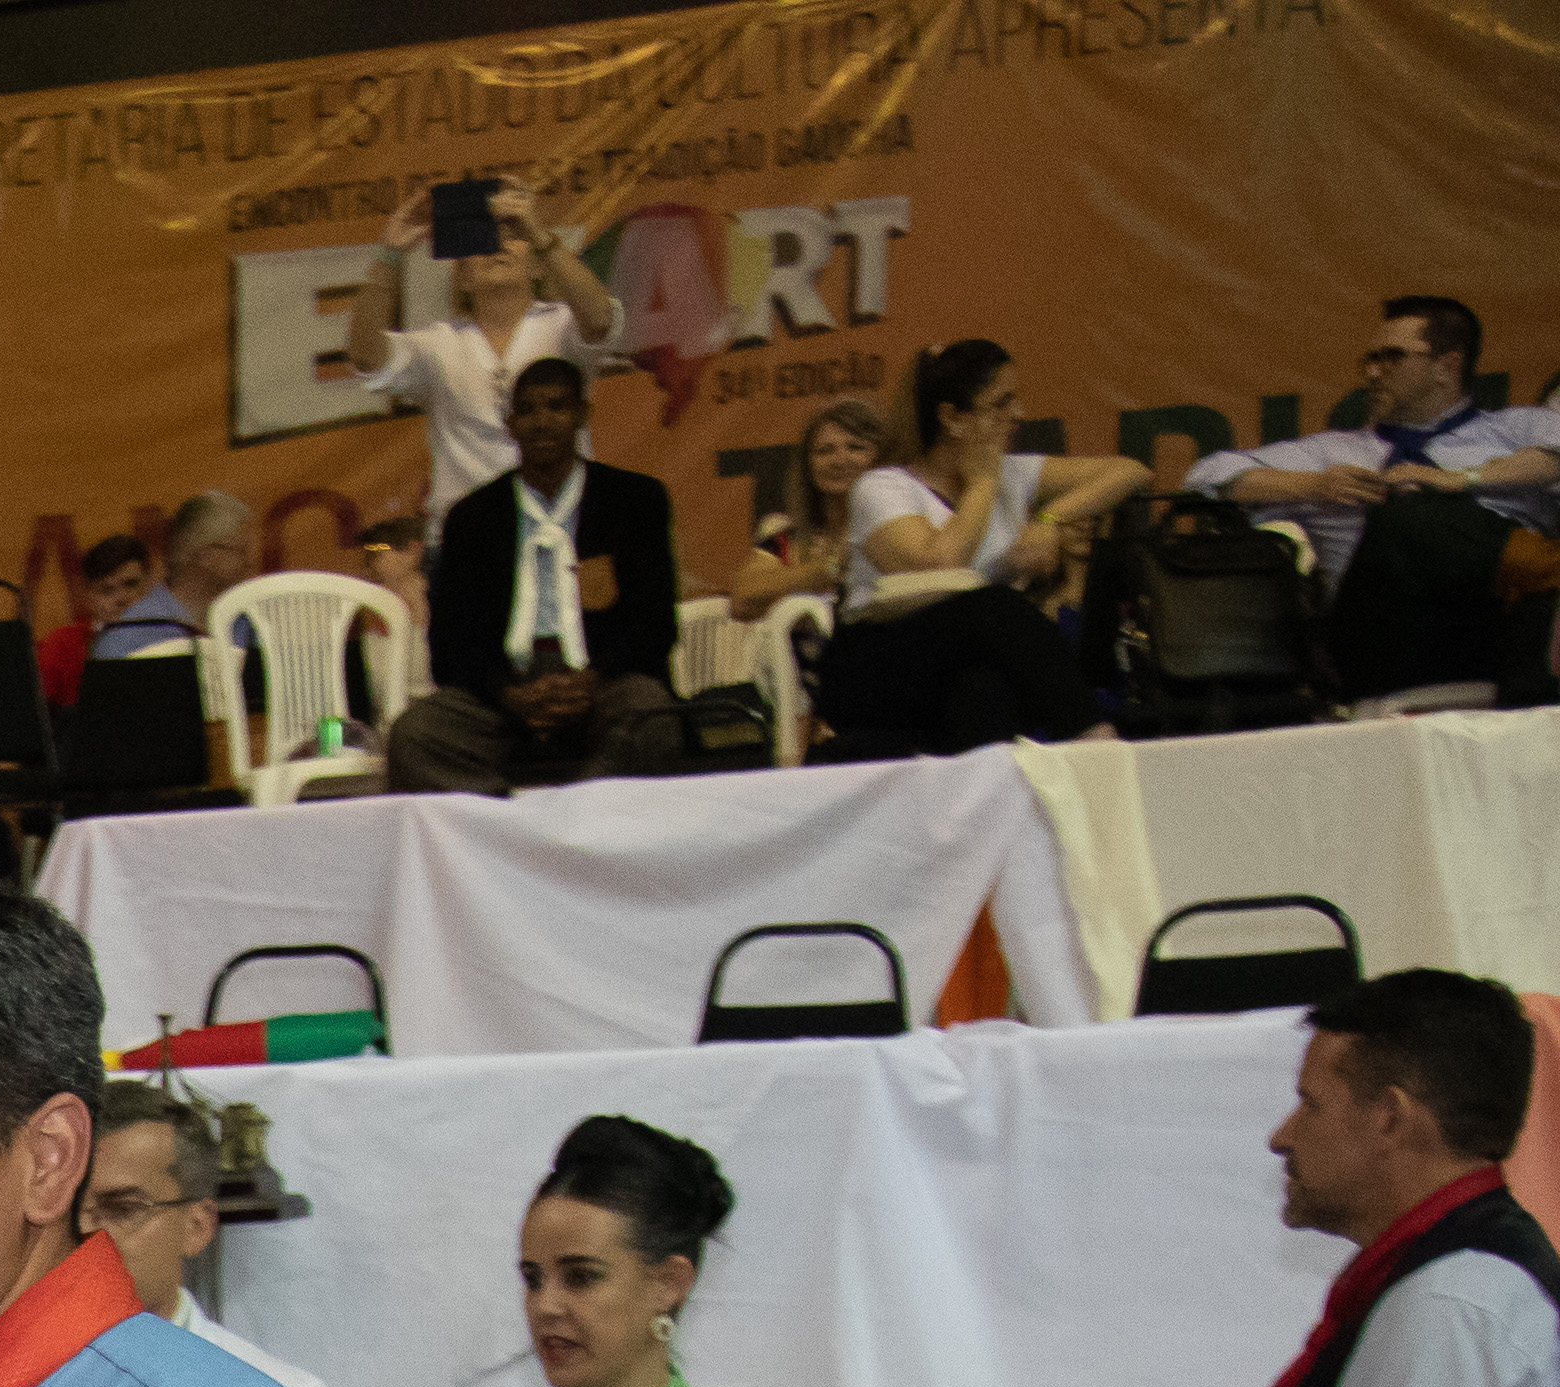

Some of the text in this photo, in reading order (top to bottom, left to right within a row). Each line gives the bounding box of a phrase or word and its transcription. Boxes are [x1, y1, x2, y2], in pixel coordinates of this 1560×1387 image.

[222, 85, 290, 162] DE
[314, 50, 536, 160] ESTADO
[230, 194, 914, 448] EART
